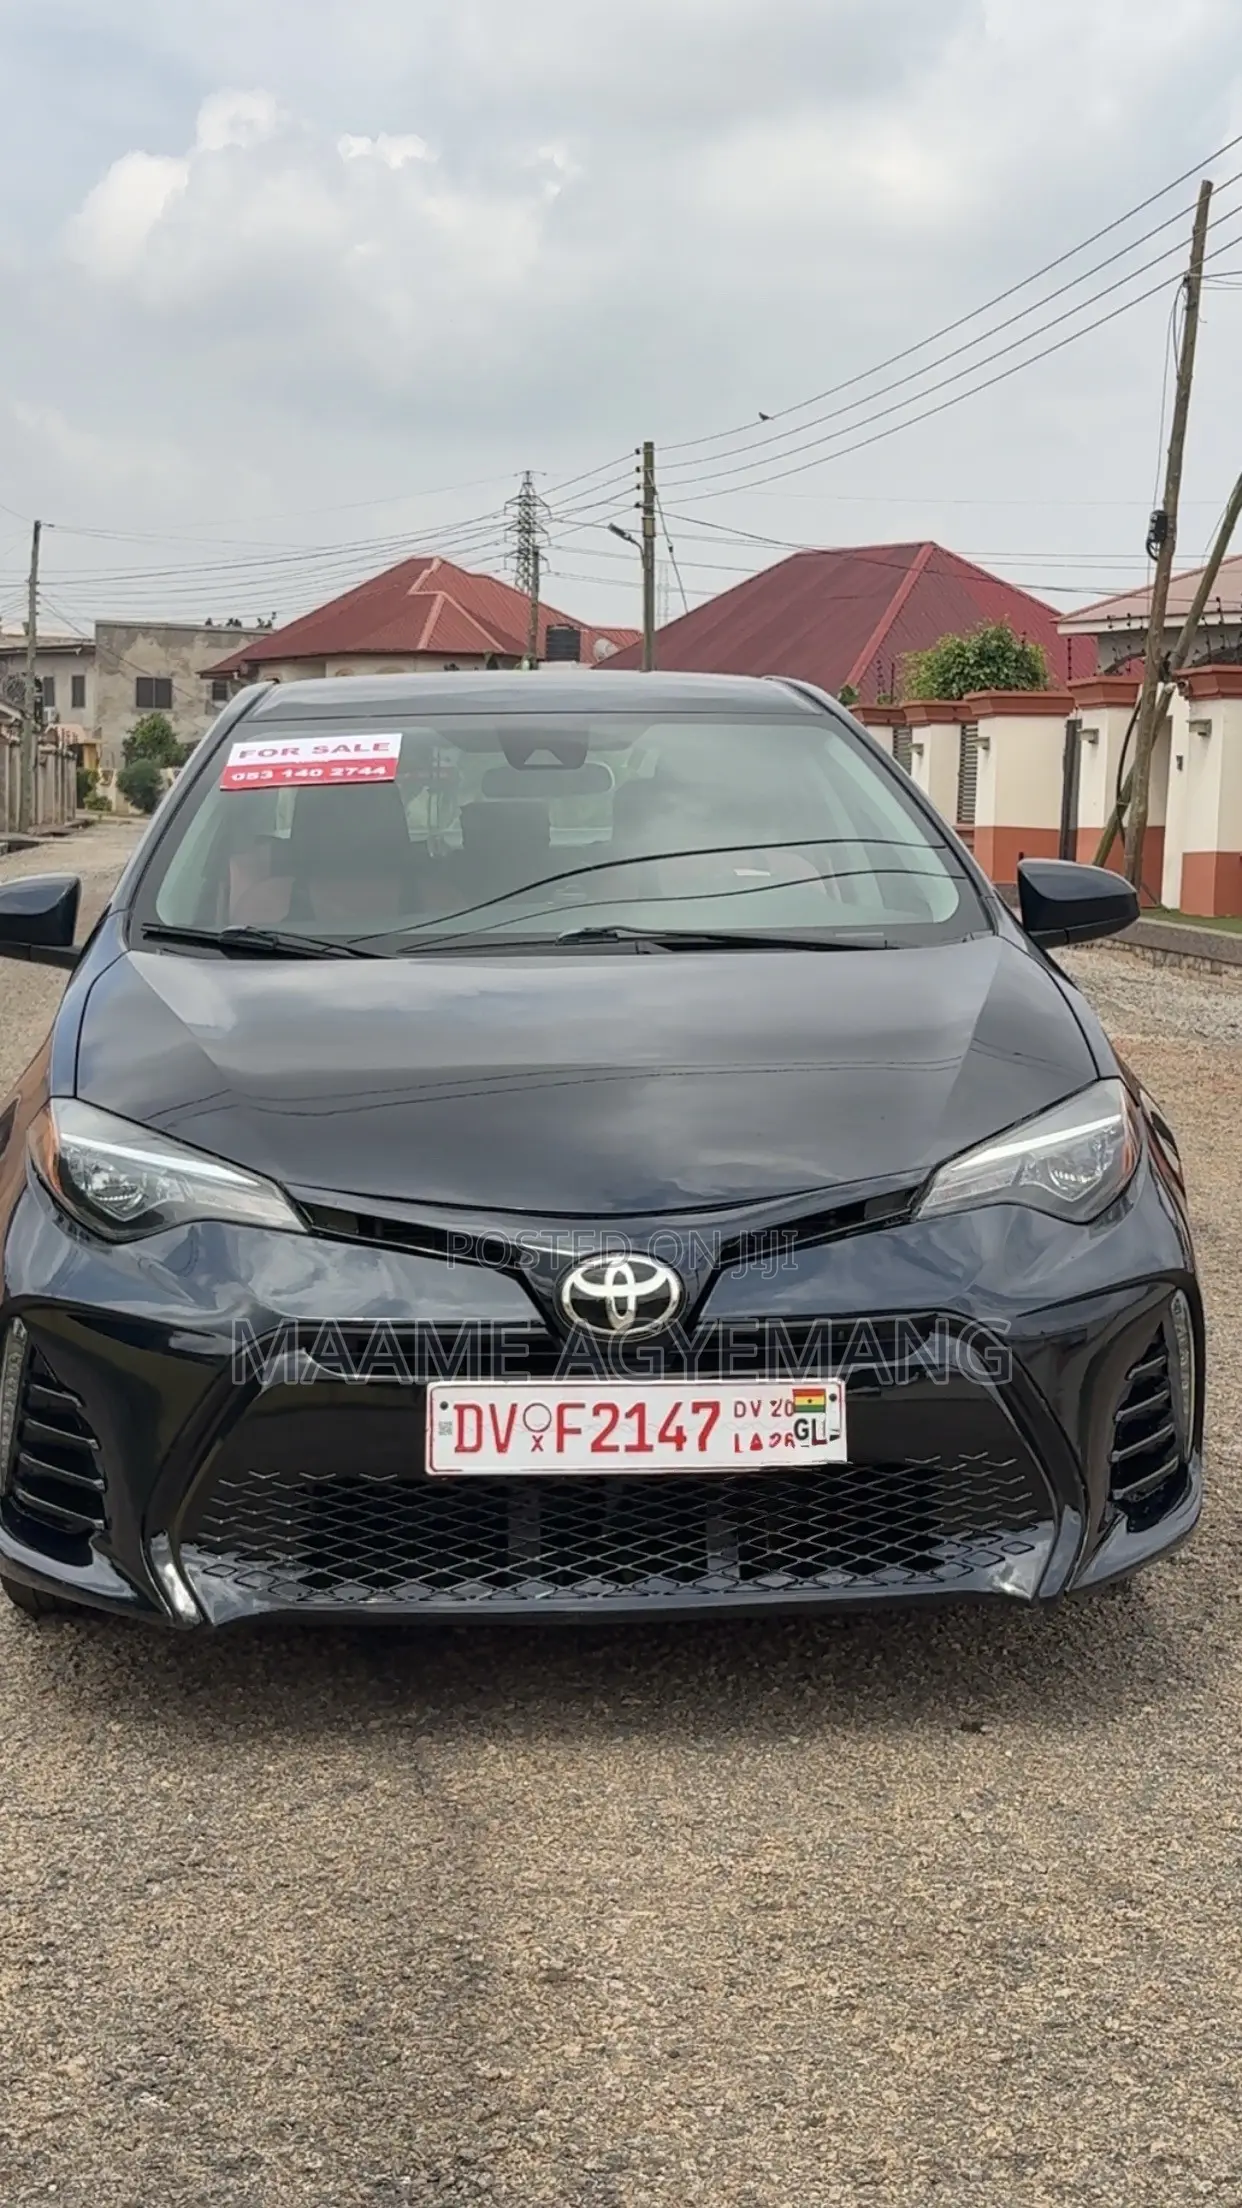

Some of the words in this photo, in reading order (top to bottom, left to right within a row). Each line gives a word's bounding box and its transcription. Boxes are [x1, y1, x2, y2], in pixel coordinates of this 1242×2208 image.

[238, 747, 300, 759] FOR
[311, 742, 391, 755] SALE
[231, 769, 274, 781] 053
[281, 767, 324, 778] 140
[329, 765, 387, 777] 2744
